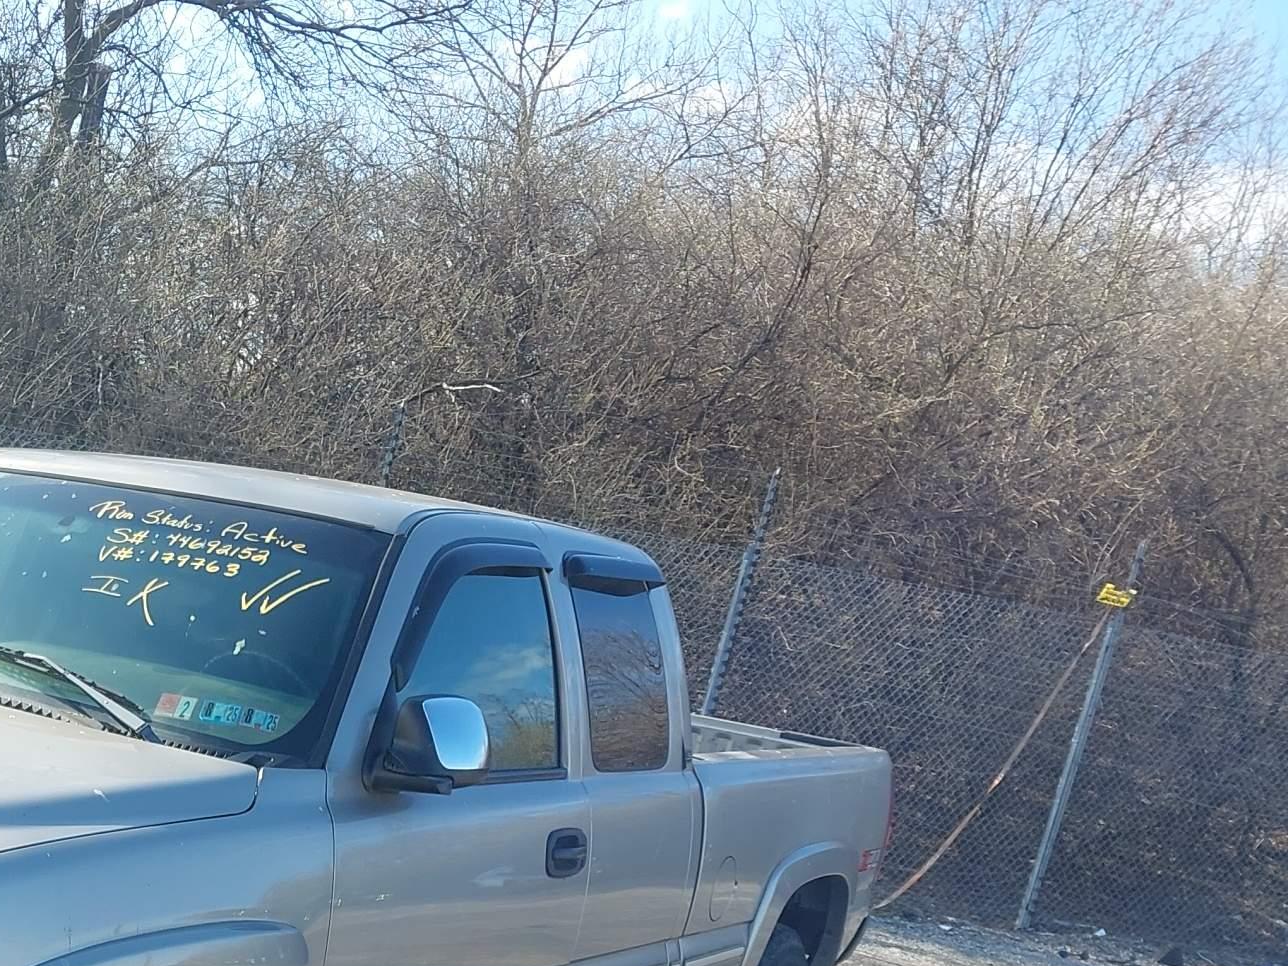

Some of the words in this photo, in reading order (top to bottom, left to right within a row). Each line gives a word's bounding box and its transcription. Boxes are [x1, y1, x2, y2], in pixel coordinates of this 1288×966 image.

[166, 532, 270, 566] 44692152
[220, 521, 308, 555] Active
[148, 549, 241, 577] 179763
[178, 700, 191, 718] 2
